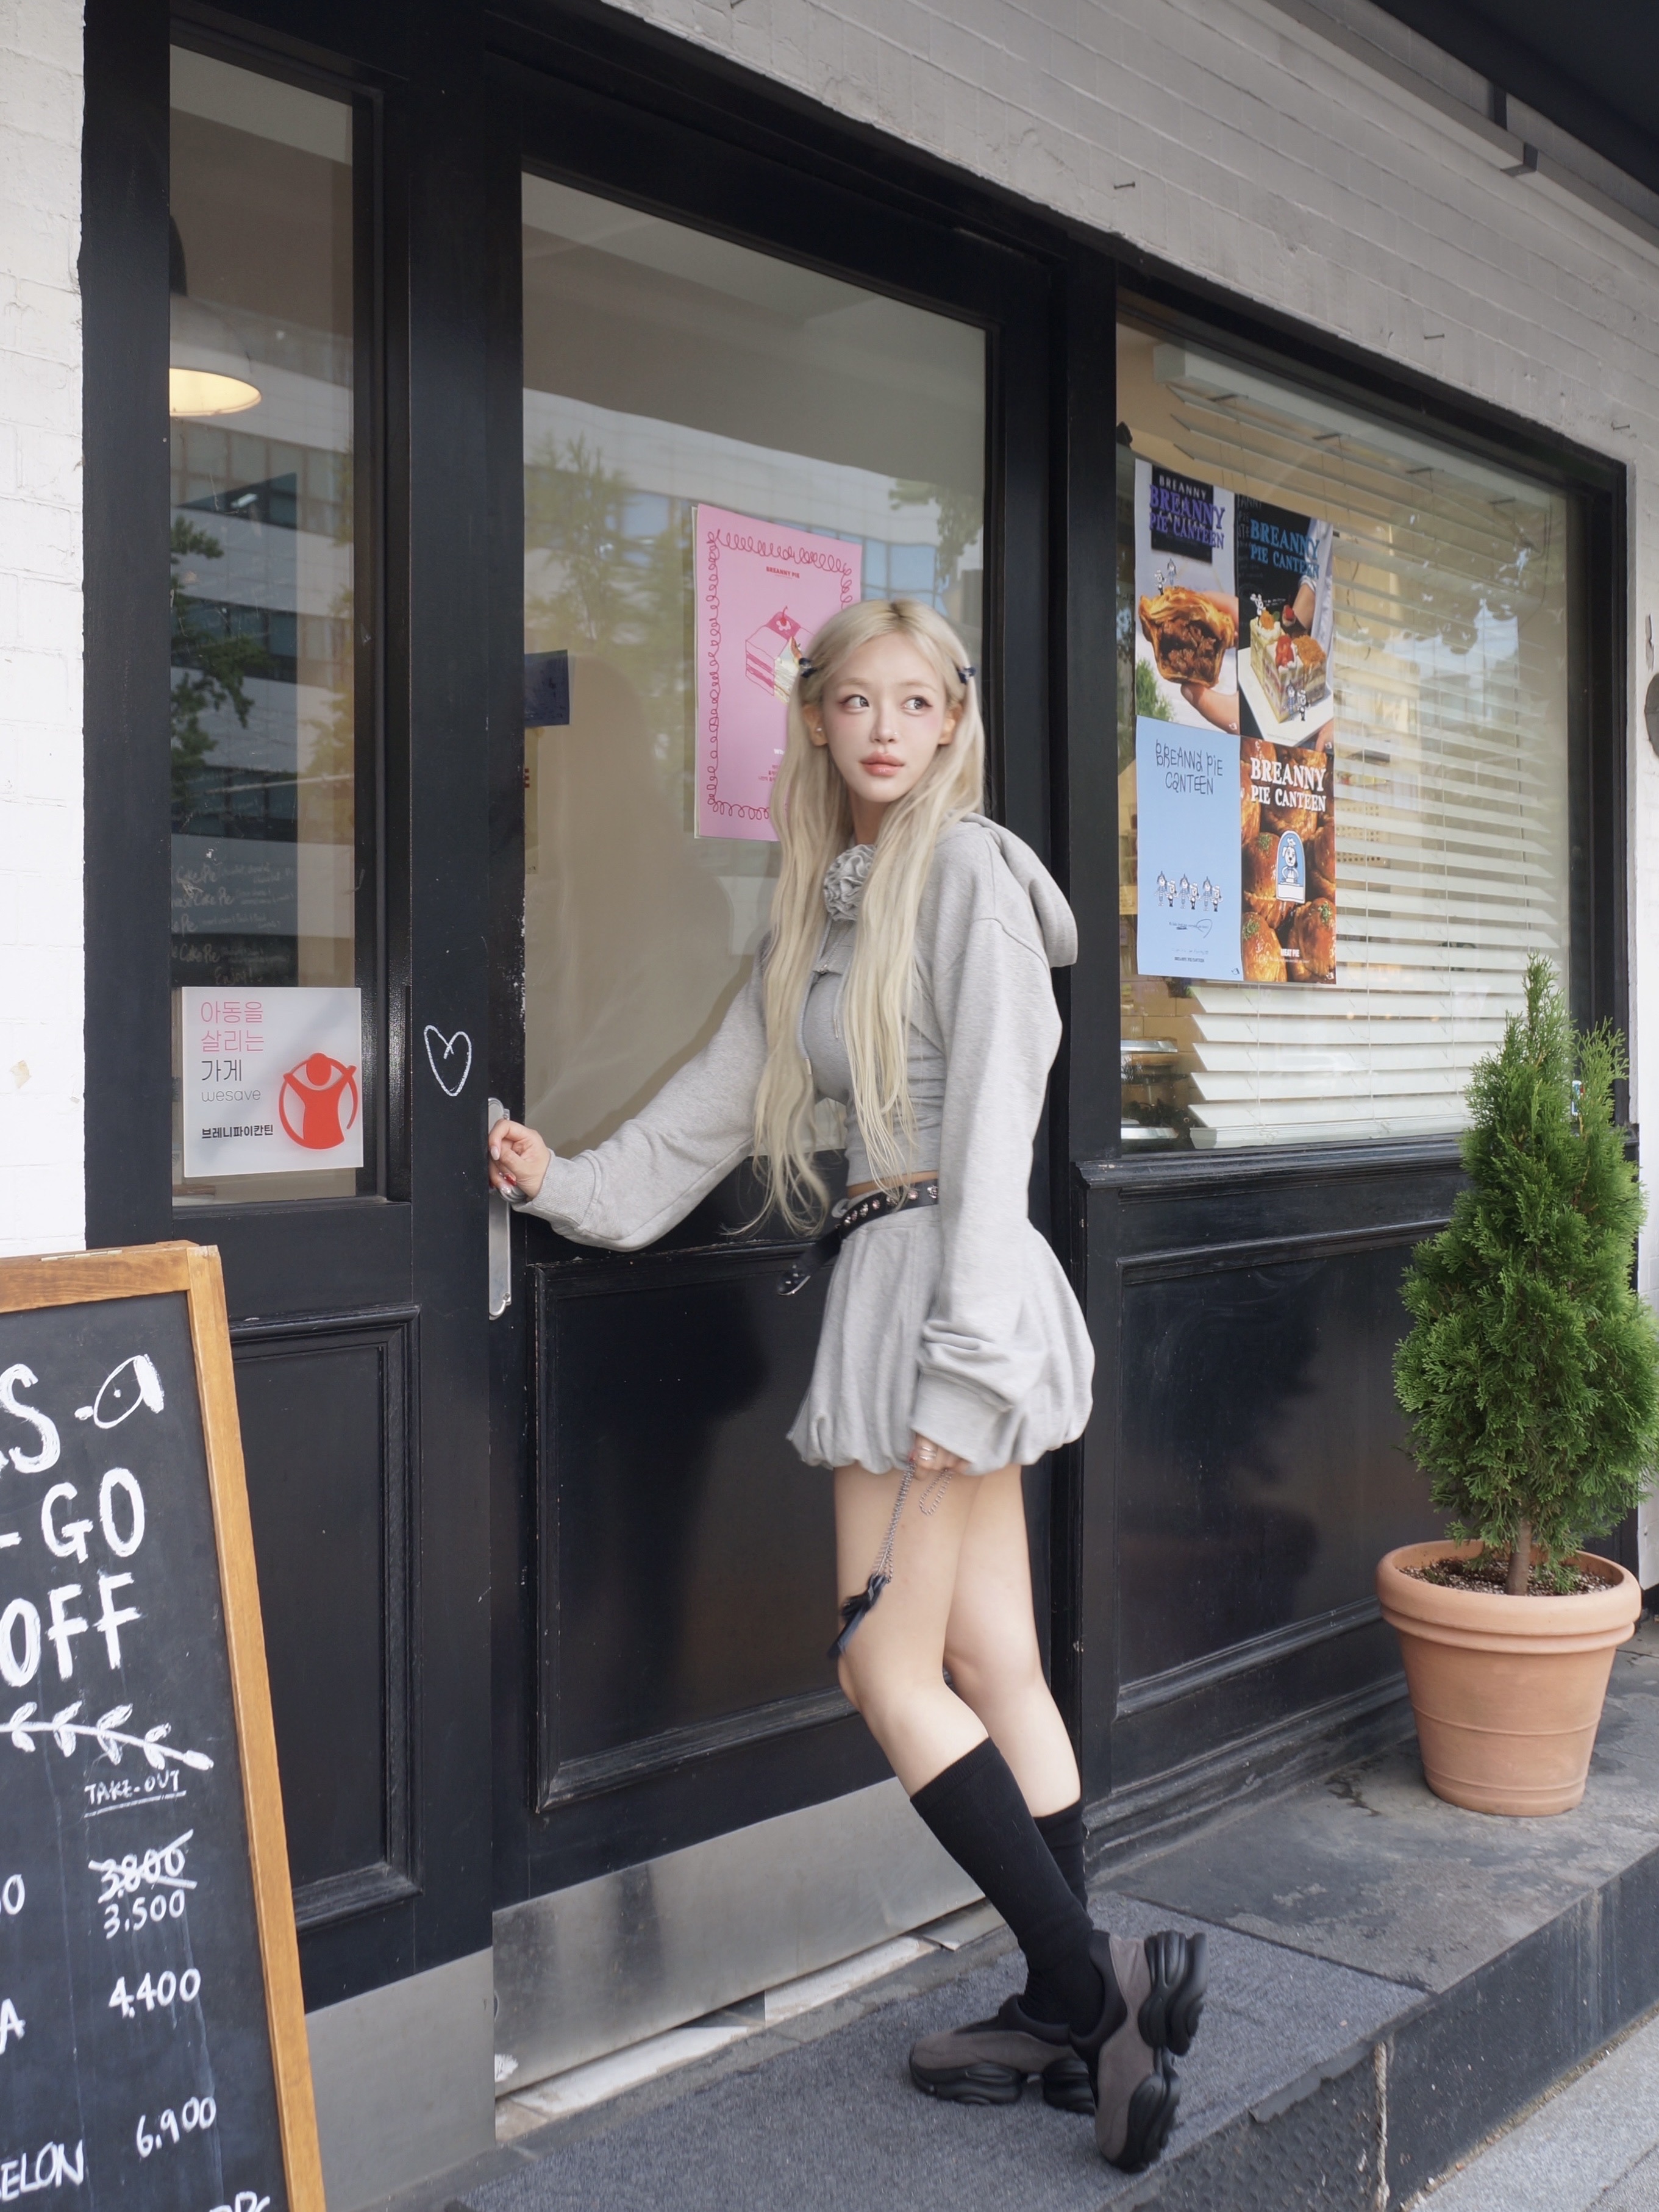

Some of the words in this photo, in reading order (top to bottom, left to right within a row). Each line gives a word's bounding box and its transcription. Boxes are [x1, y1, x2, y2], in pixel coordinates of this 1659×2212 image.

[1149, 484, 1226, 530] BREANNY
[1149, 512, 1168, 533] PIE
[1173, 517, 1224, 549] CANTEEN
[1250, 518, 1320, 559] BREANNY
[1250, 543, 1268, 565] PIE
[1272, 551, 1319, 579] CANTEEN
[1250, 757, 1326, 791] BREANNY
[1251, 785, 1271, 805] PIE
[1275, 788, 1326, 812] CANTEEN
[201, 1001, 263, 1023] 아동을
[201, 1030, 264, 1052] 살리는
[201, 1059, 241, 1082] 가게
[201, 1090, 261, 1102] wesave
[202, 1124, 274, 1139] 브레니파이칸틴
[0, 1363, 60, 1474] S
[0, 2139, 84, 2202] ELON
